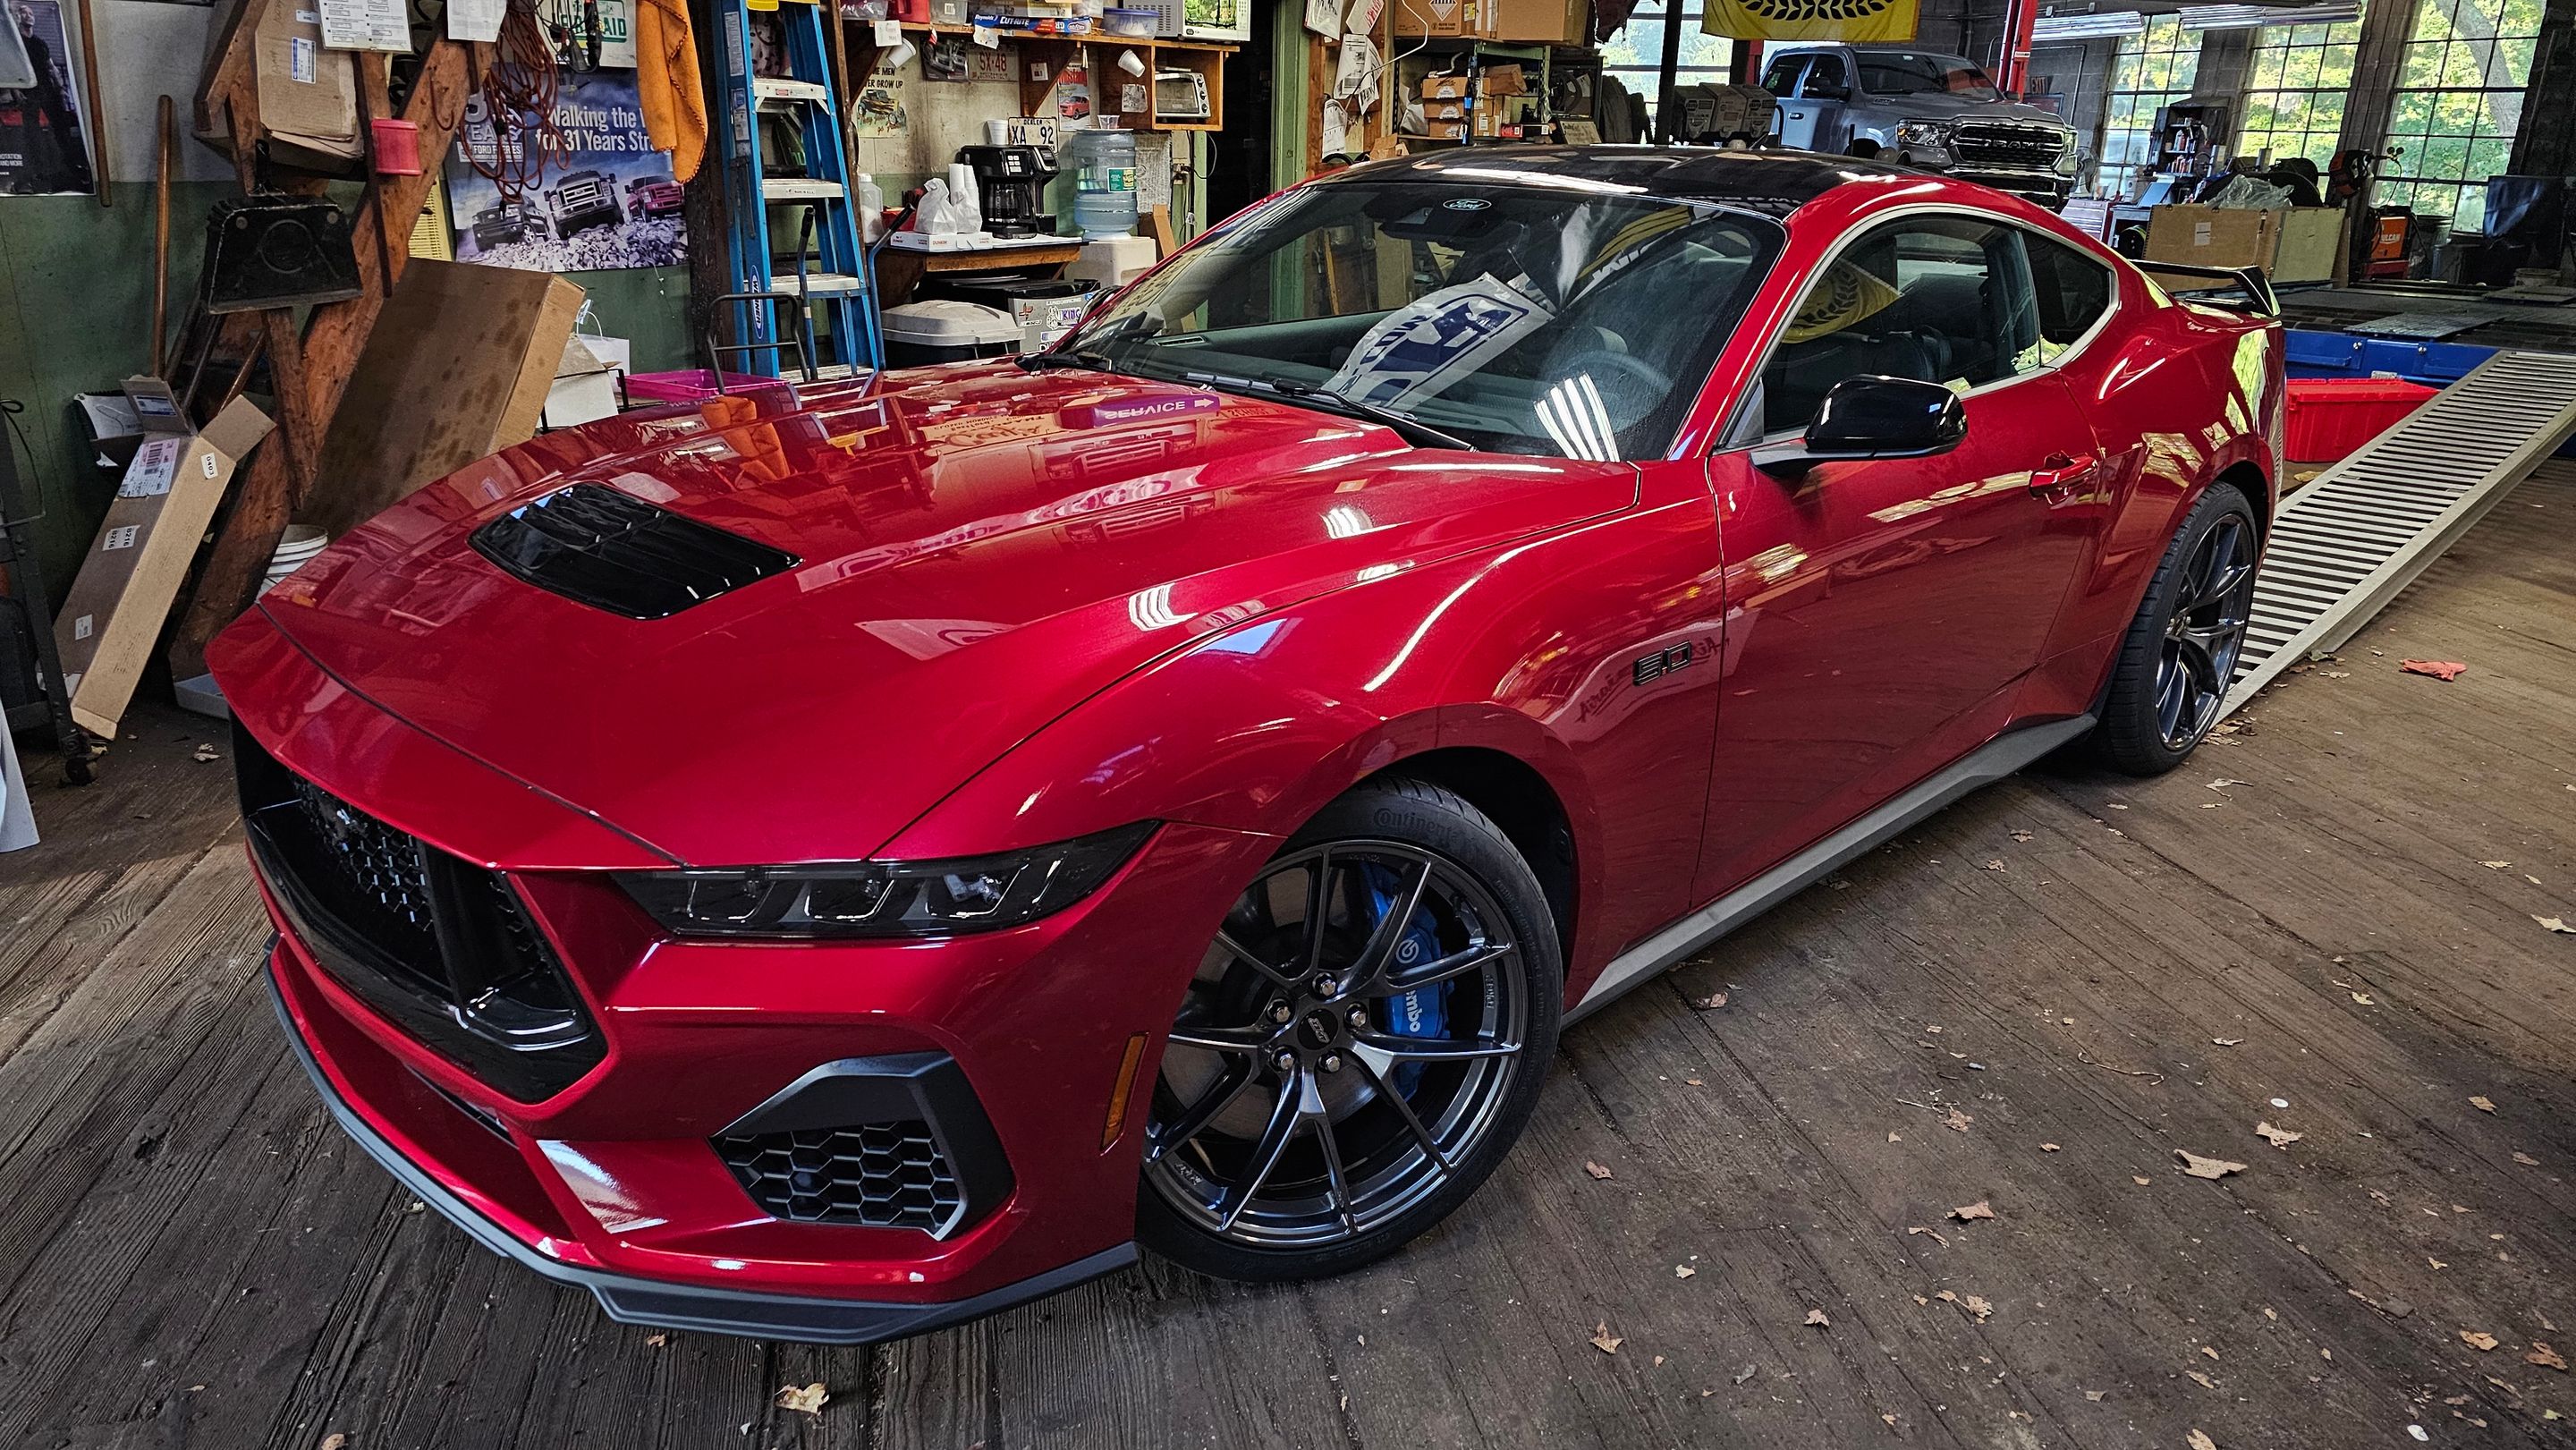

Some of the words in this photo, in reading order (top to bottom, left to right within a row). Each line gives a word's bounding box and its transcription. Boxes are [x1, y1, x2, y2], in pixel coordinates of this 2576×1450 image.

[882, 67, 895, 76] MEN
[877, 80, 894, 89] GROW
[895, 80, 903, 89] UP
[2031, 76, 2046, 94] EXIT
[611, 106, 637, 128] the
[564, 129, 580, 151] 31
[583, 130, 626, 152] Years
[1012, 125, 1027, 144] XA
[1040, 126, 1055, 144] 92
[2380, 233, 2401, 242] ULCAN
[752, 280, 761, 324] WENER
[1633, 640, 1691, 687] 5.0
